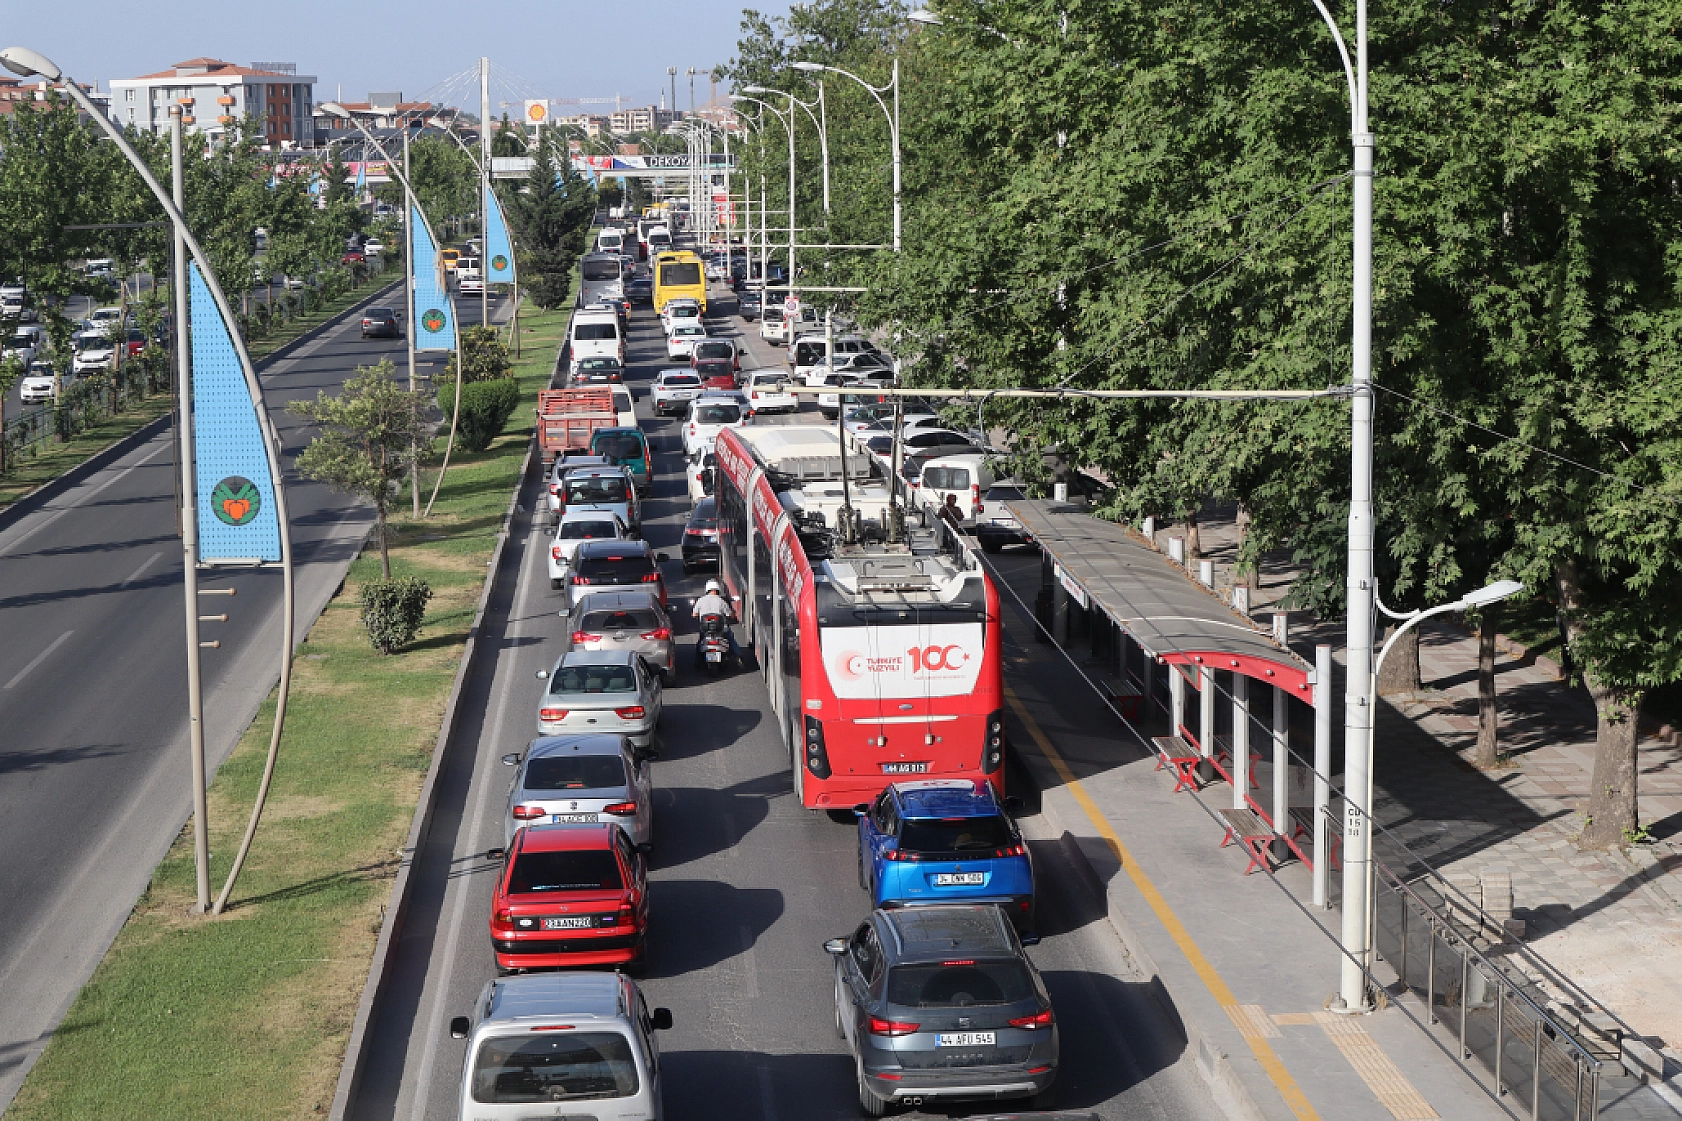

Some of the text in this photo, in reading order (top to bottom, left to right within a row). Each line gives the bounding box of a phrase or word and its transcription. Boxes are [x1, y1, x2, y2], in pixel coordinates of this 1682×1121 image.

[941, 1033, 993, 1045] 44 AFU 545
